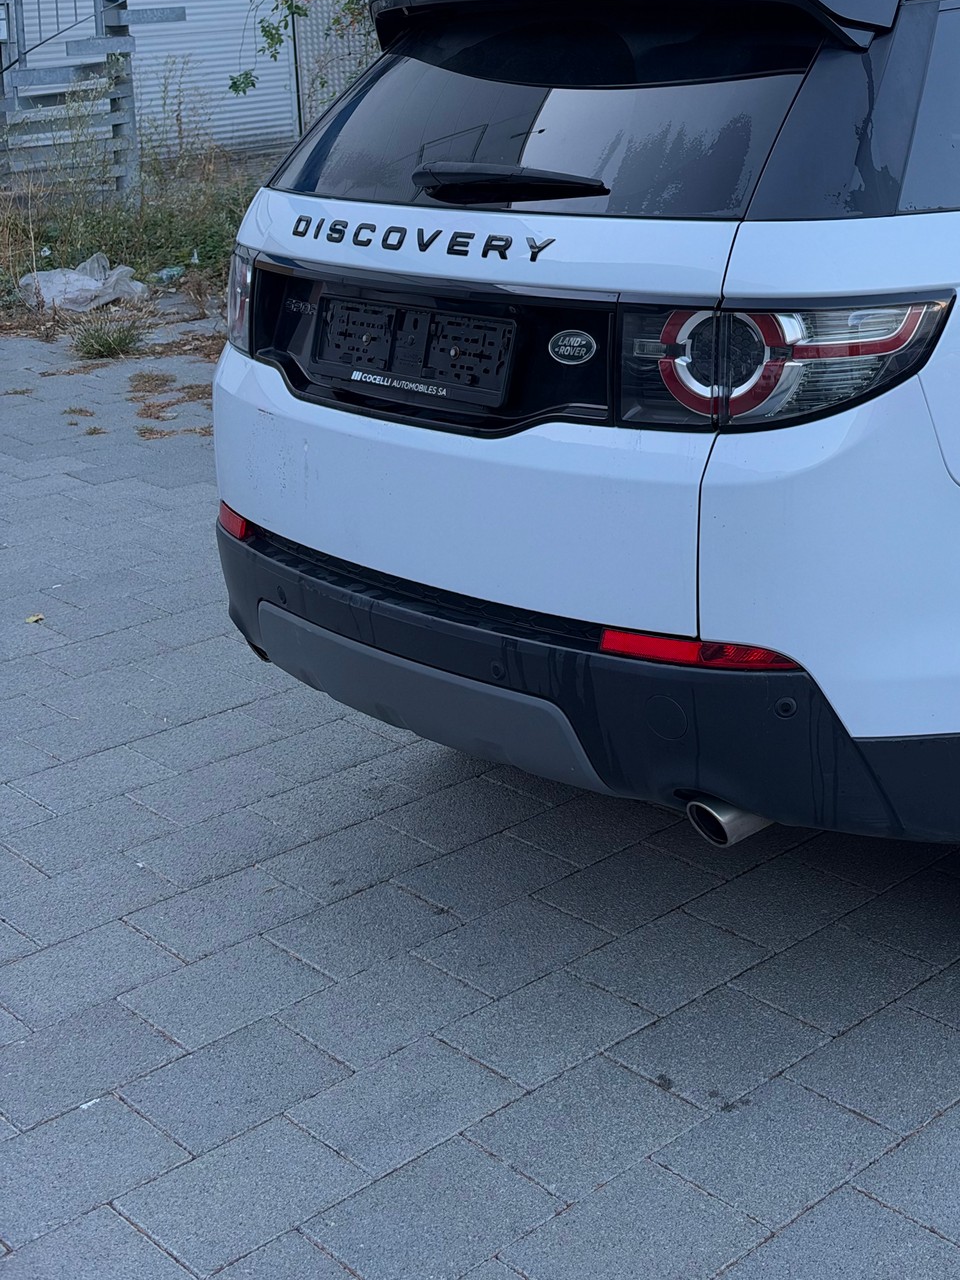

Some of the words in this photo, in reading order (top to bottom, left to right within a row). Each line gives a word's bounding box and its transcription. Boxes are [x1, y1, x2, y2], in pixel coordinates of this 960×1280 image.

[292, 215, 556, 262] DISCOVERY
[558, 336, 581, 347] LAND
[558, 345, 587, 357] ROVER
[361, 373, 392, 386] COCELLI
[391, 379, 437, 395] AUTOMOBILES
[437, 387, 447, 396] SA
